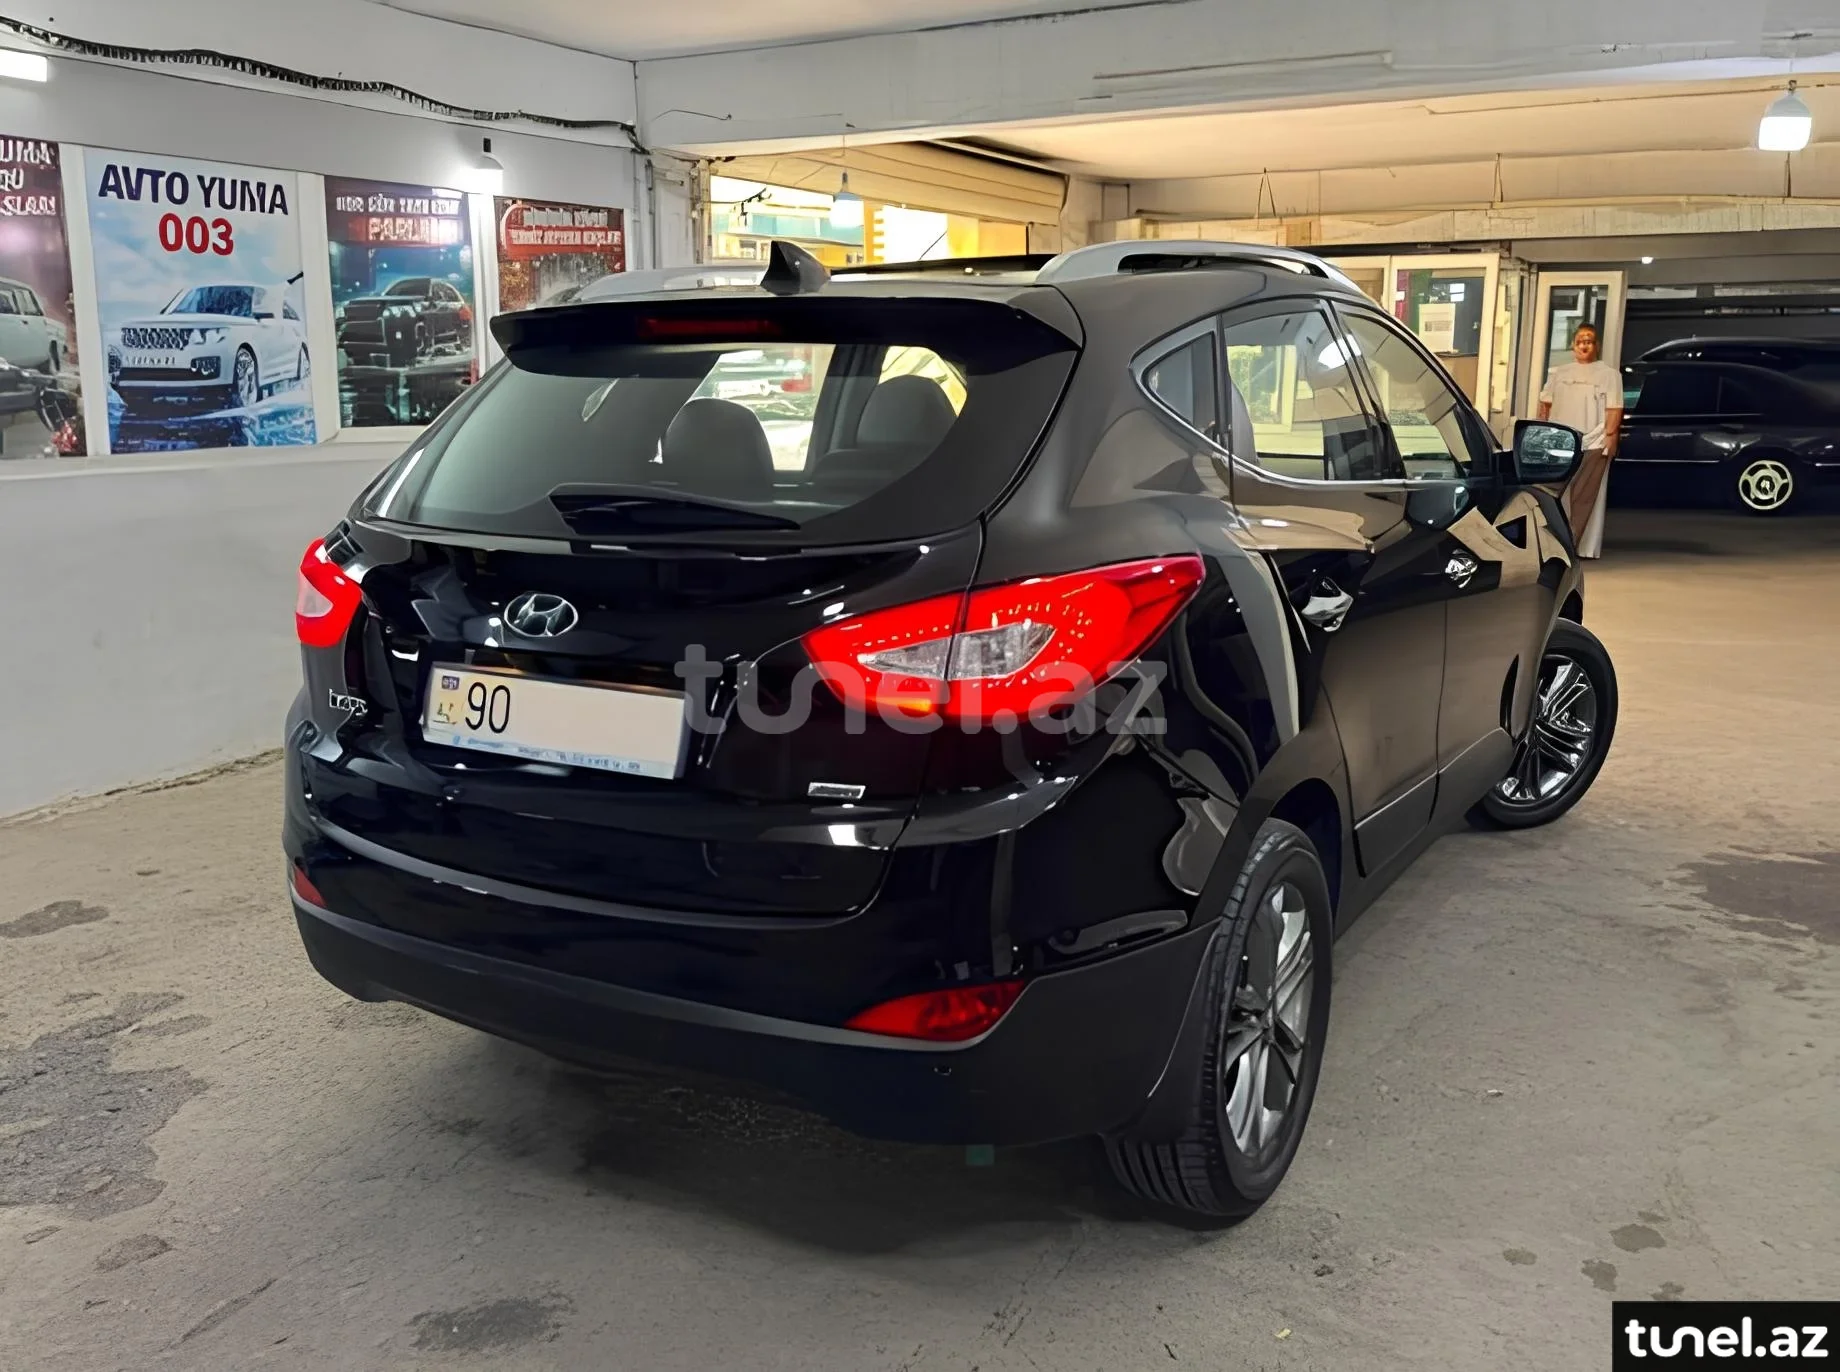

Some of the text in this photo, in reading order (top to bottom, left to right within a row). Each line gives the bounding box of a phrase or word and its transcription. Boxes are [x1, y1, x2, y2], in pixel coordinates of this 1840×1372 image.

[98, 164, 189, 205] AVTO
[197, 175, 288, 215] YUMA
[159, 213, 234, 255] 003
[465, 681, 511, 733] 90
